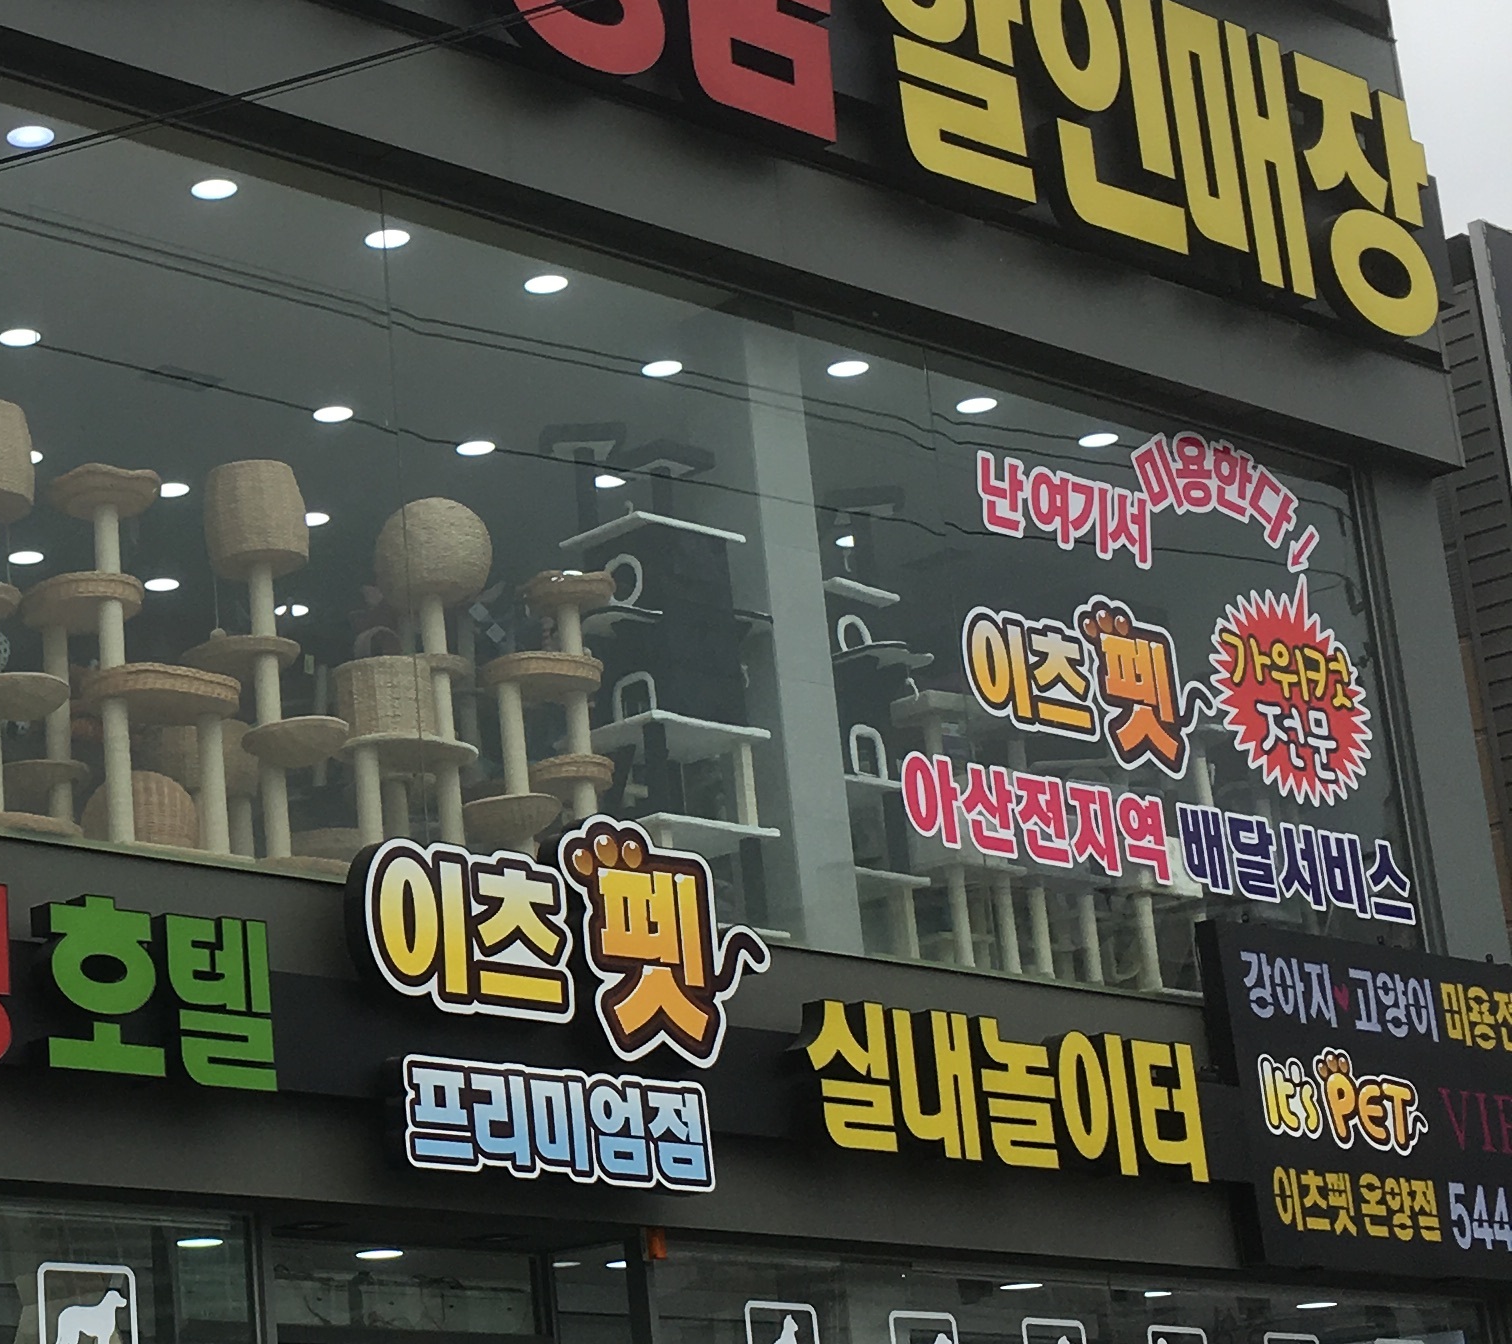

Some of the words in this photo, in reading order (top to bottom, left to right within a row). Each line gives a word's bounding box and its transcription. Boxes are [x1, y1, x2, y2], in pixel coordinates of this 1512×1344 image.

[979, 452, 1153, 566] 난여기서
[1134, 435, 1297, 544] 미용한다
[970, 616, 1180, 763] 이츠펫
[1220, 630, 1354, 709] 가위컷
[1255, 701, 1338, 781] 전문
[903, 755, 1171, 883] 아산전지역
[1178, 804, 1415, 924] 배달서비스
[46, 895, 279, 1092] 호텔
[375, 857, 711, 1047] 이츠펫
[1240, 950, 1338, 1029] 강아지
[1348, 967, 1440, 1043] 고양이
[408, 1065, 706, 1182] 프리미엄점
[808, 1000, 1210, 1184] 실내놀이터
[1261, 1059, 1319, 1131] It's
[1325, 1071, 1413, 1146] PET
[1272, 1166, 1358, 1237] 이츠펫
[1359, 1172, 1443, 1243] 온양점
